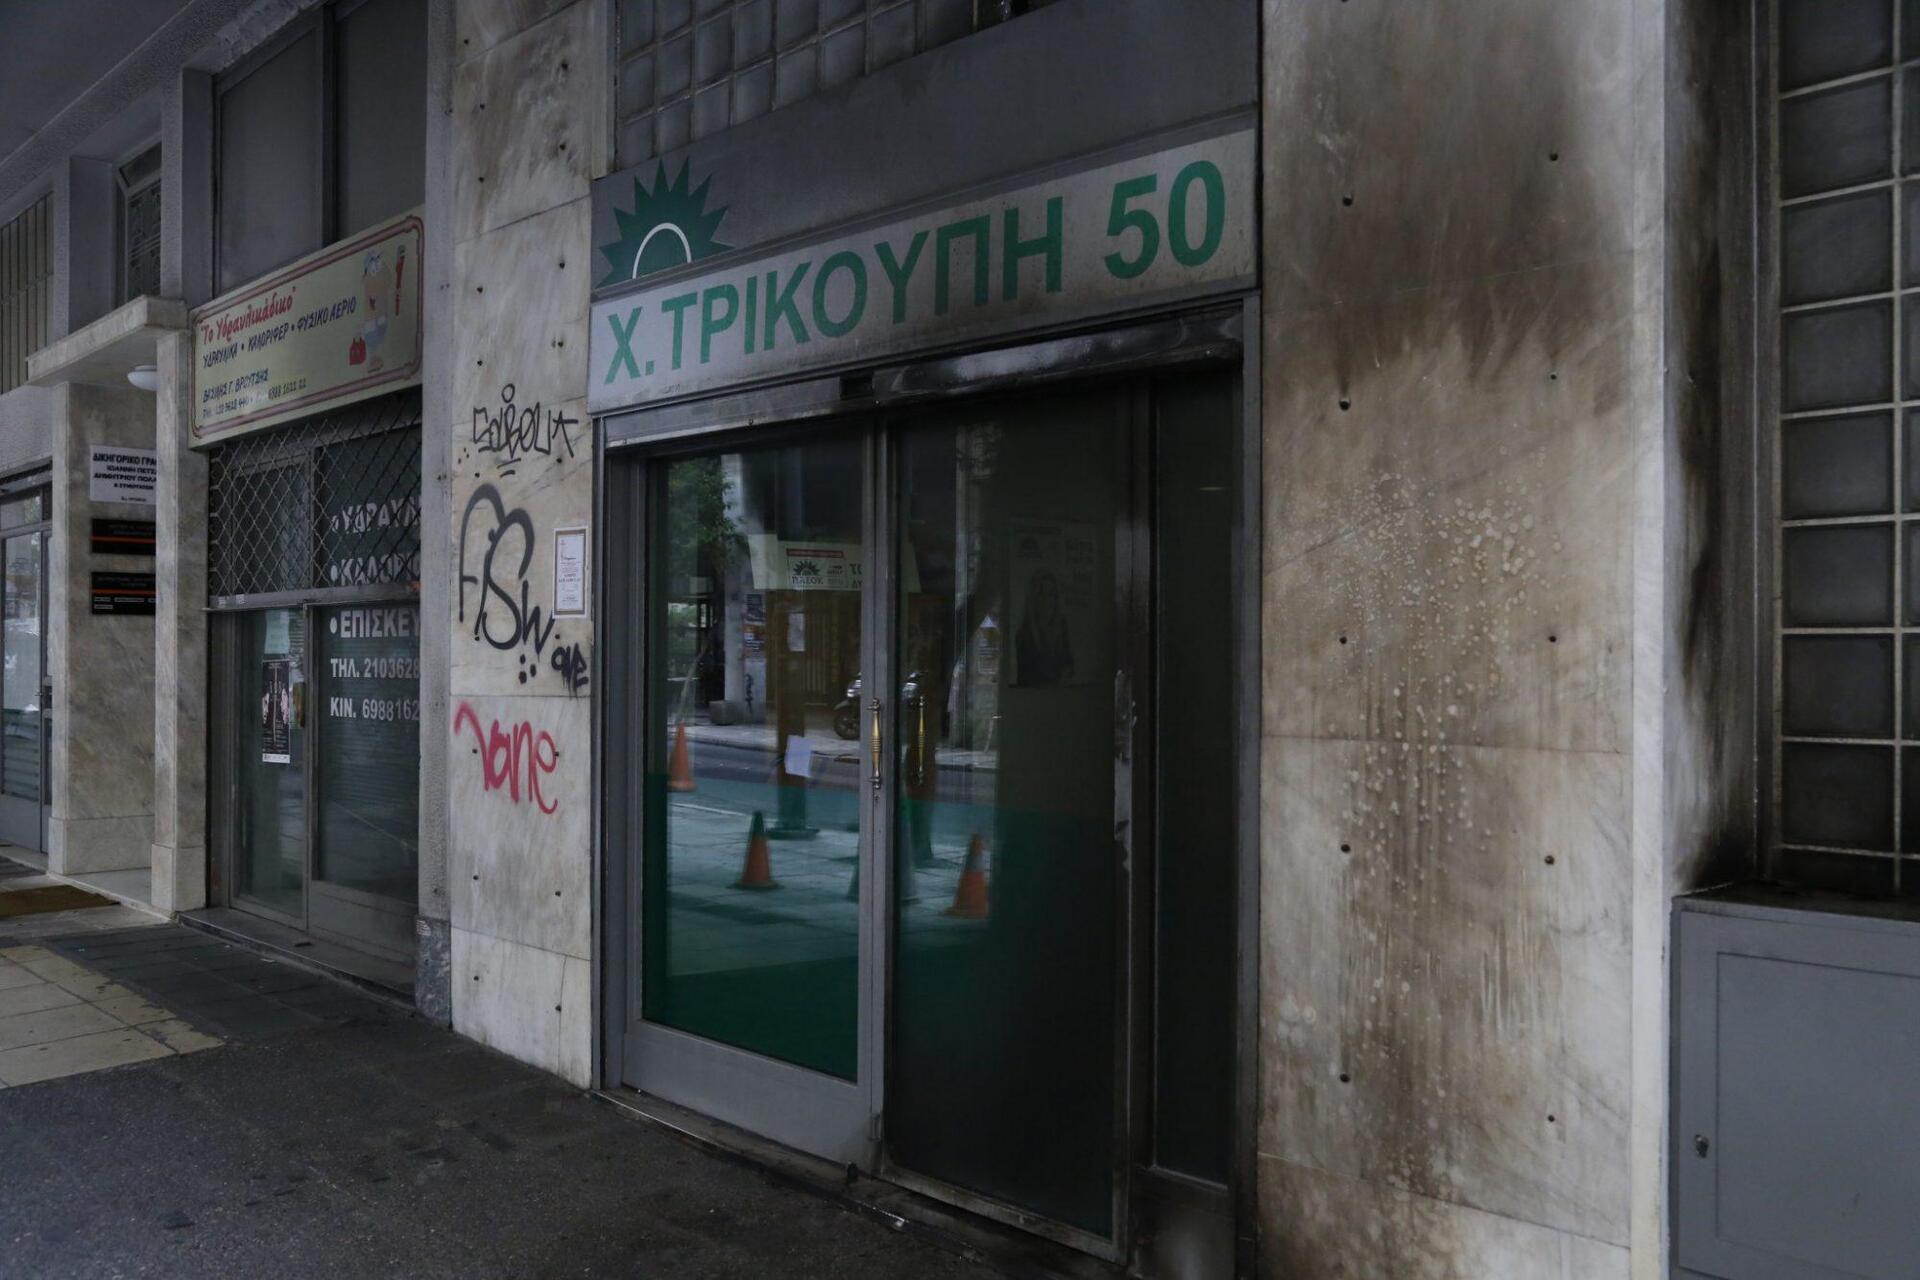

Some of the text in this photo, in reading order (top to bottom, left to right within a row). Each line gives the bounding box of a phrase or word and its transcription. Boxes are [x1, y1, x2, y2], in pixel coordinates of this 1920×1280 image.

[1103, 160, 1226, 279] 50
[248, 322, 290, 352] ΚΑΛΟΡΙΦΕΡ
[297, 307, 329, 333] ΦΥΣΙΚΟ
[330, 296, 357, 321] ΑΕΡΙΟ
[331, 658, 360, 677] ΤΗΛ.
[330, 697, 357, 718] ΚΙΝ.
